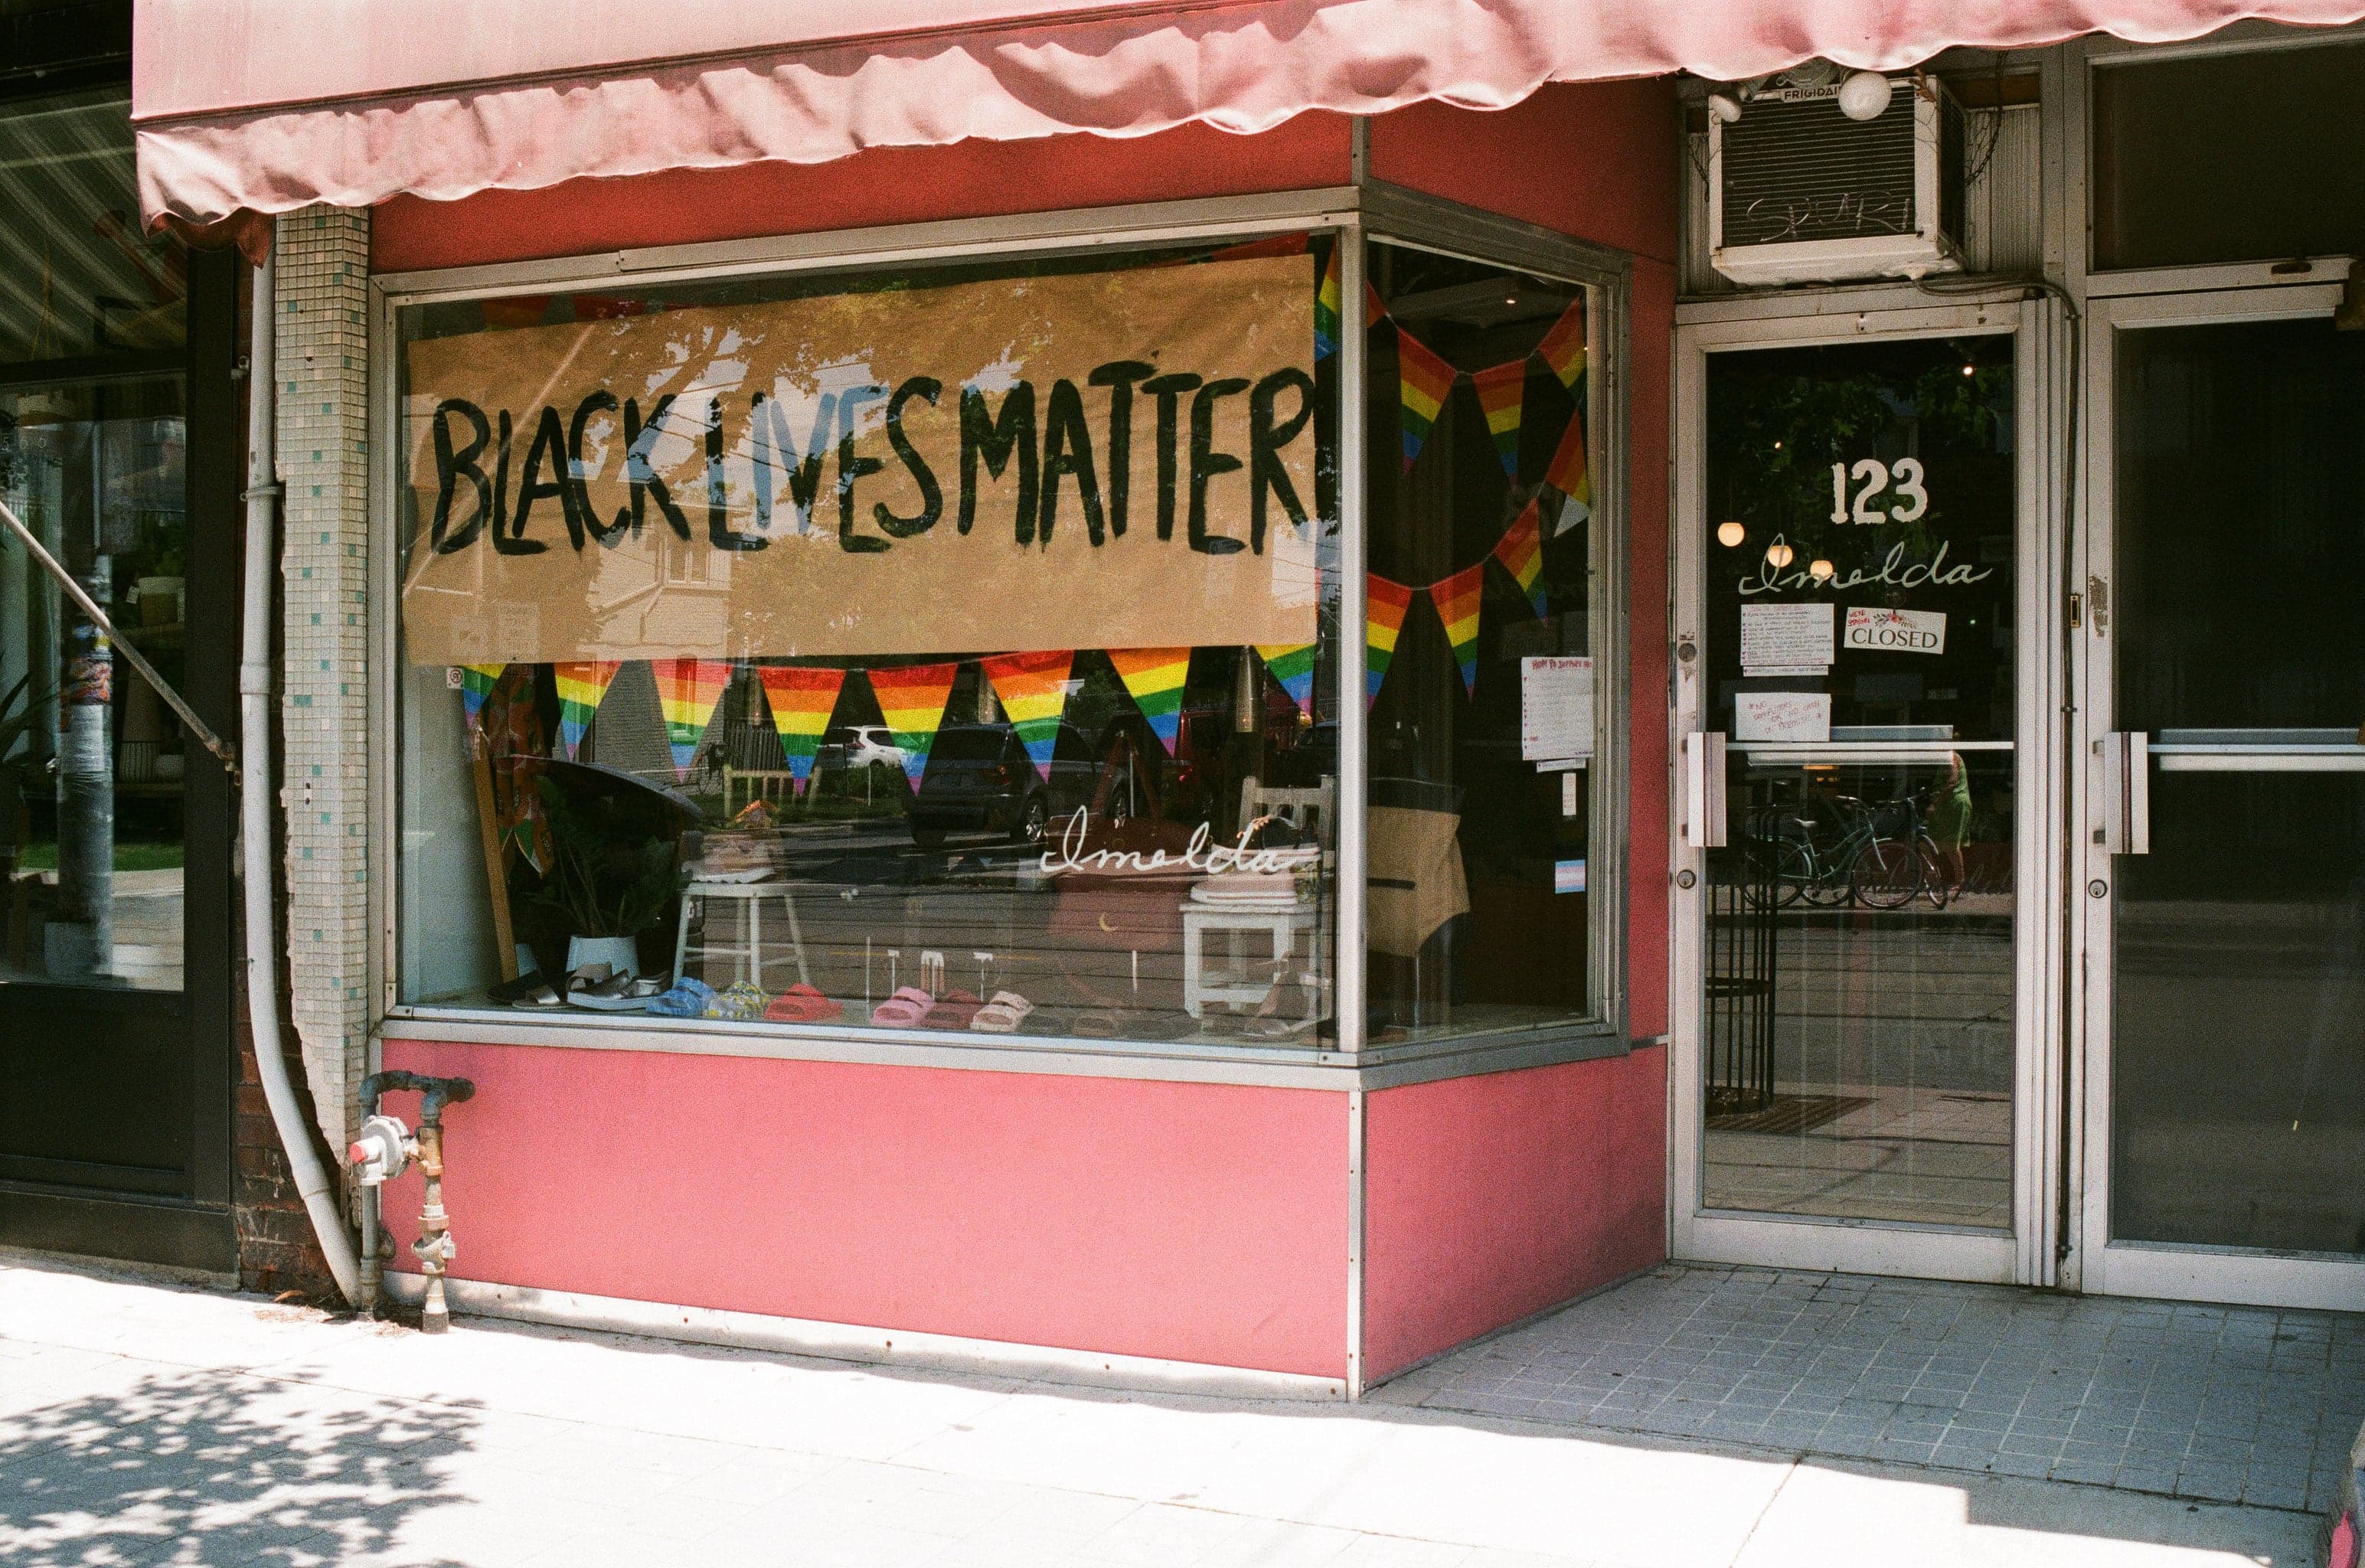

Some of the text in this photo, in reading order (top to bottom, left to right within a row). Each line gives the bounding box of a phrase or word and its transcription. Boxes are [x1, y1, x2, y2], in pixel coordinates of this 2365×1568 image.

[1784, 86, 1841, 100] FRIGIDAI
[431, 360, 1316, 557] BLACK LIVES MATTER
[1830, 457, 1928, 525] 123
[1738, 533, 1993, 595] Imelda
[1851, 628, 1938, 648] CLOSED
[1040, 805, 1307, 874] Imelda
